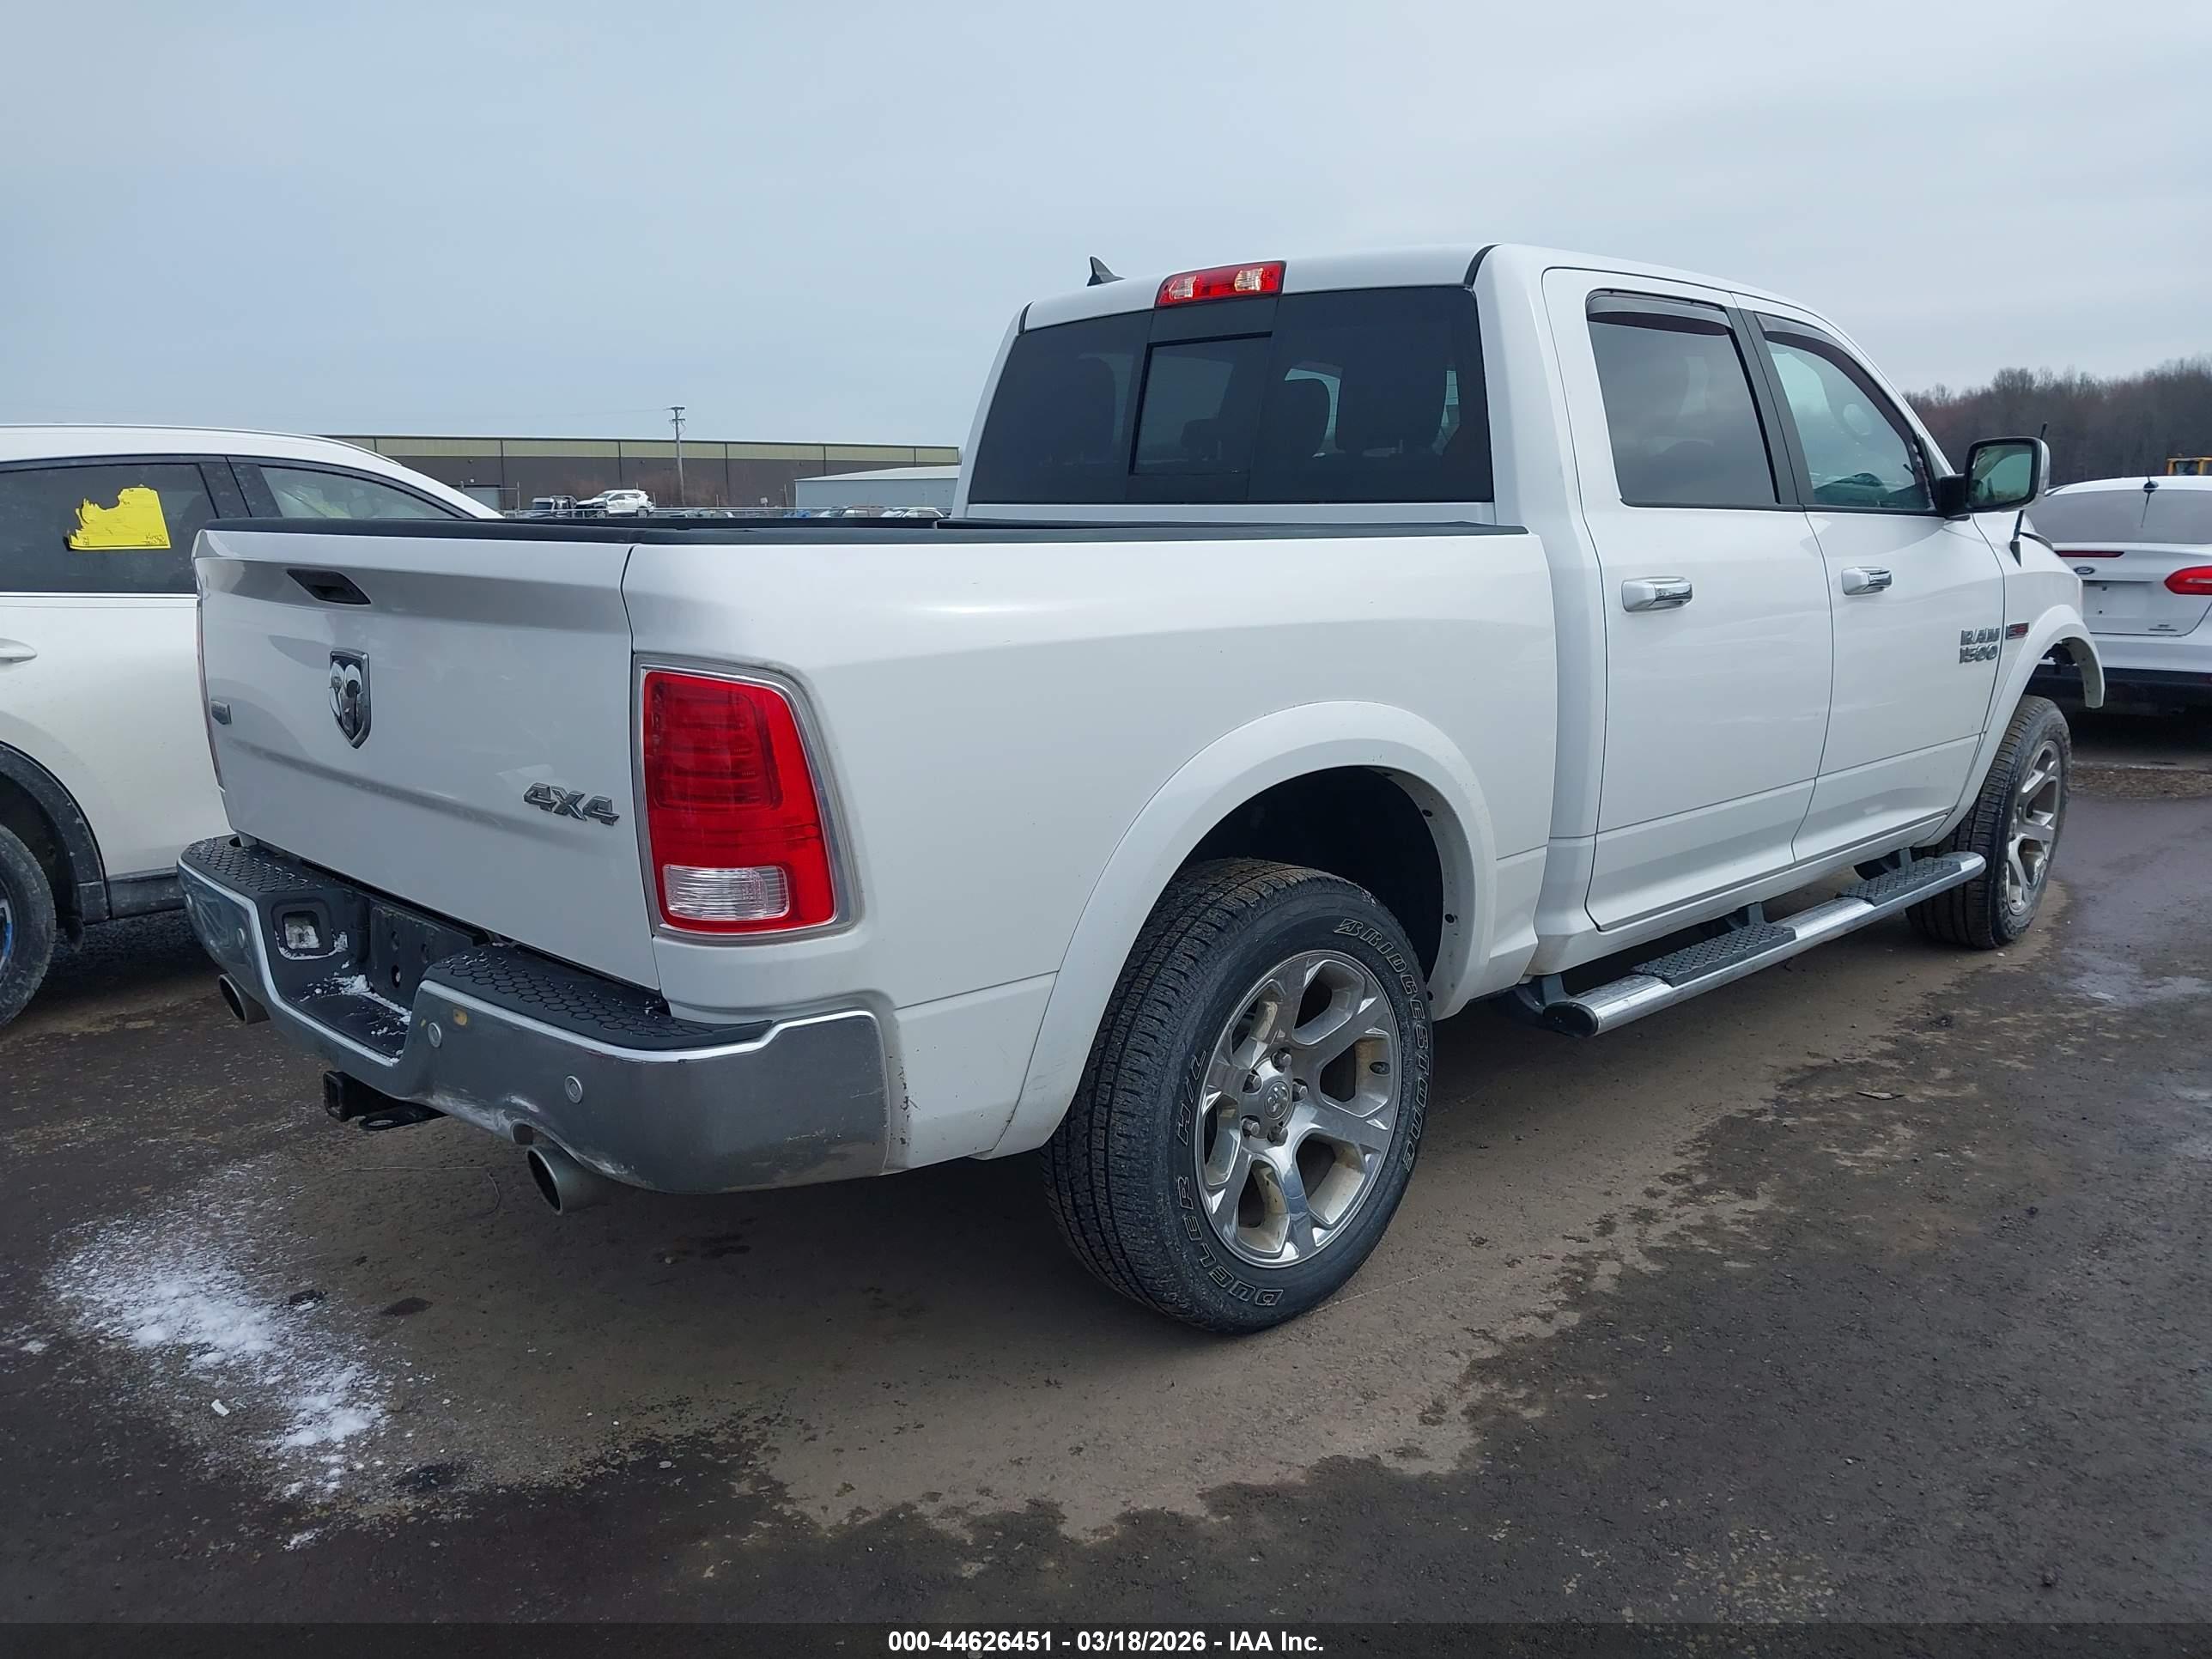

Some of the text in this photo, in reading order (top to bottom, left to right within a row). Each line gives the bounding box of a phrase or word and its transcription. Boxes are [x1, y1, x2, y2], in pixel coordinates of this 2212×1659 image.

[1959, 645, 1998, 664] 1500
[1960, 628, 2000, 646] RAM
[1333, 917, 1431, 1173] BRIDGESTONE
[1177, 1176, 1284, 1307] DUELER
